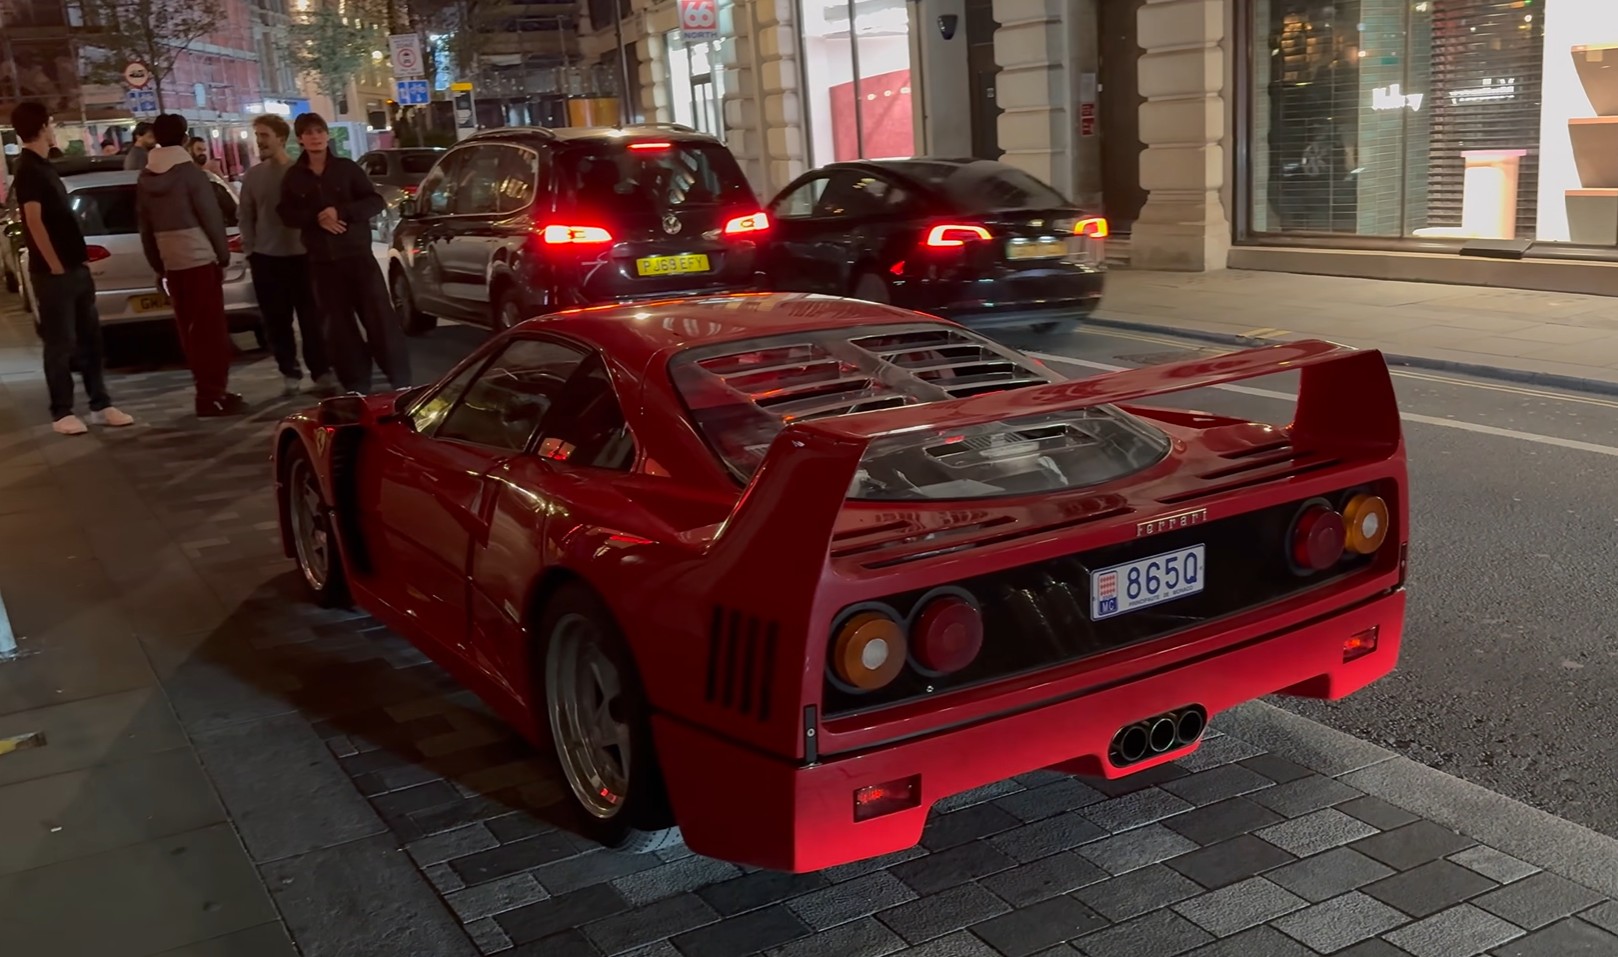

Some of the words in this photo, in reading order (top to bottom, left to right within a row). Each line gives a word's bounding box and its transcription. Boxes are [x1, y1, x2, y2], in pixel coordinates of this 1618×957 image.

[684, 31, 717, 39] NORTH
[1137, 508, 1207, 536] Ferrari
[1127, 552, 1197, 599] 865Q
[1172, 586, 1194, 595] MONACO
[1102, 600, 1114, 612] MC
